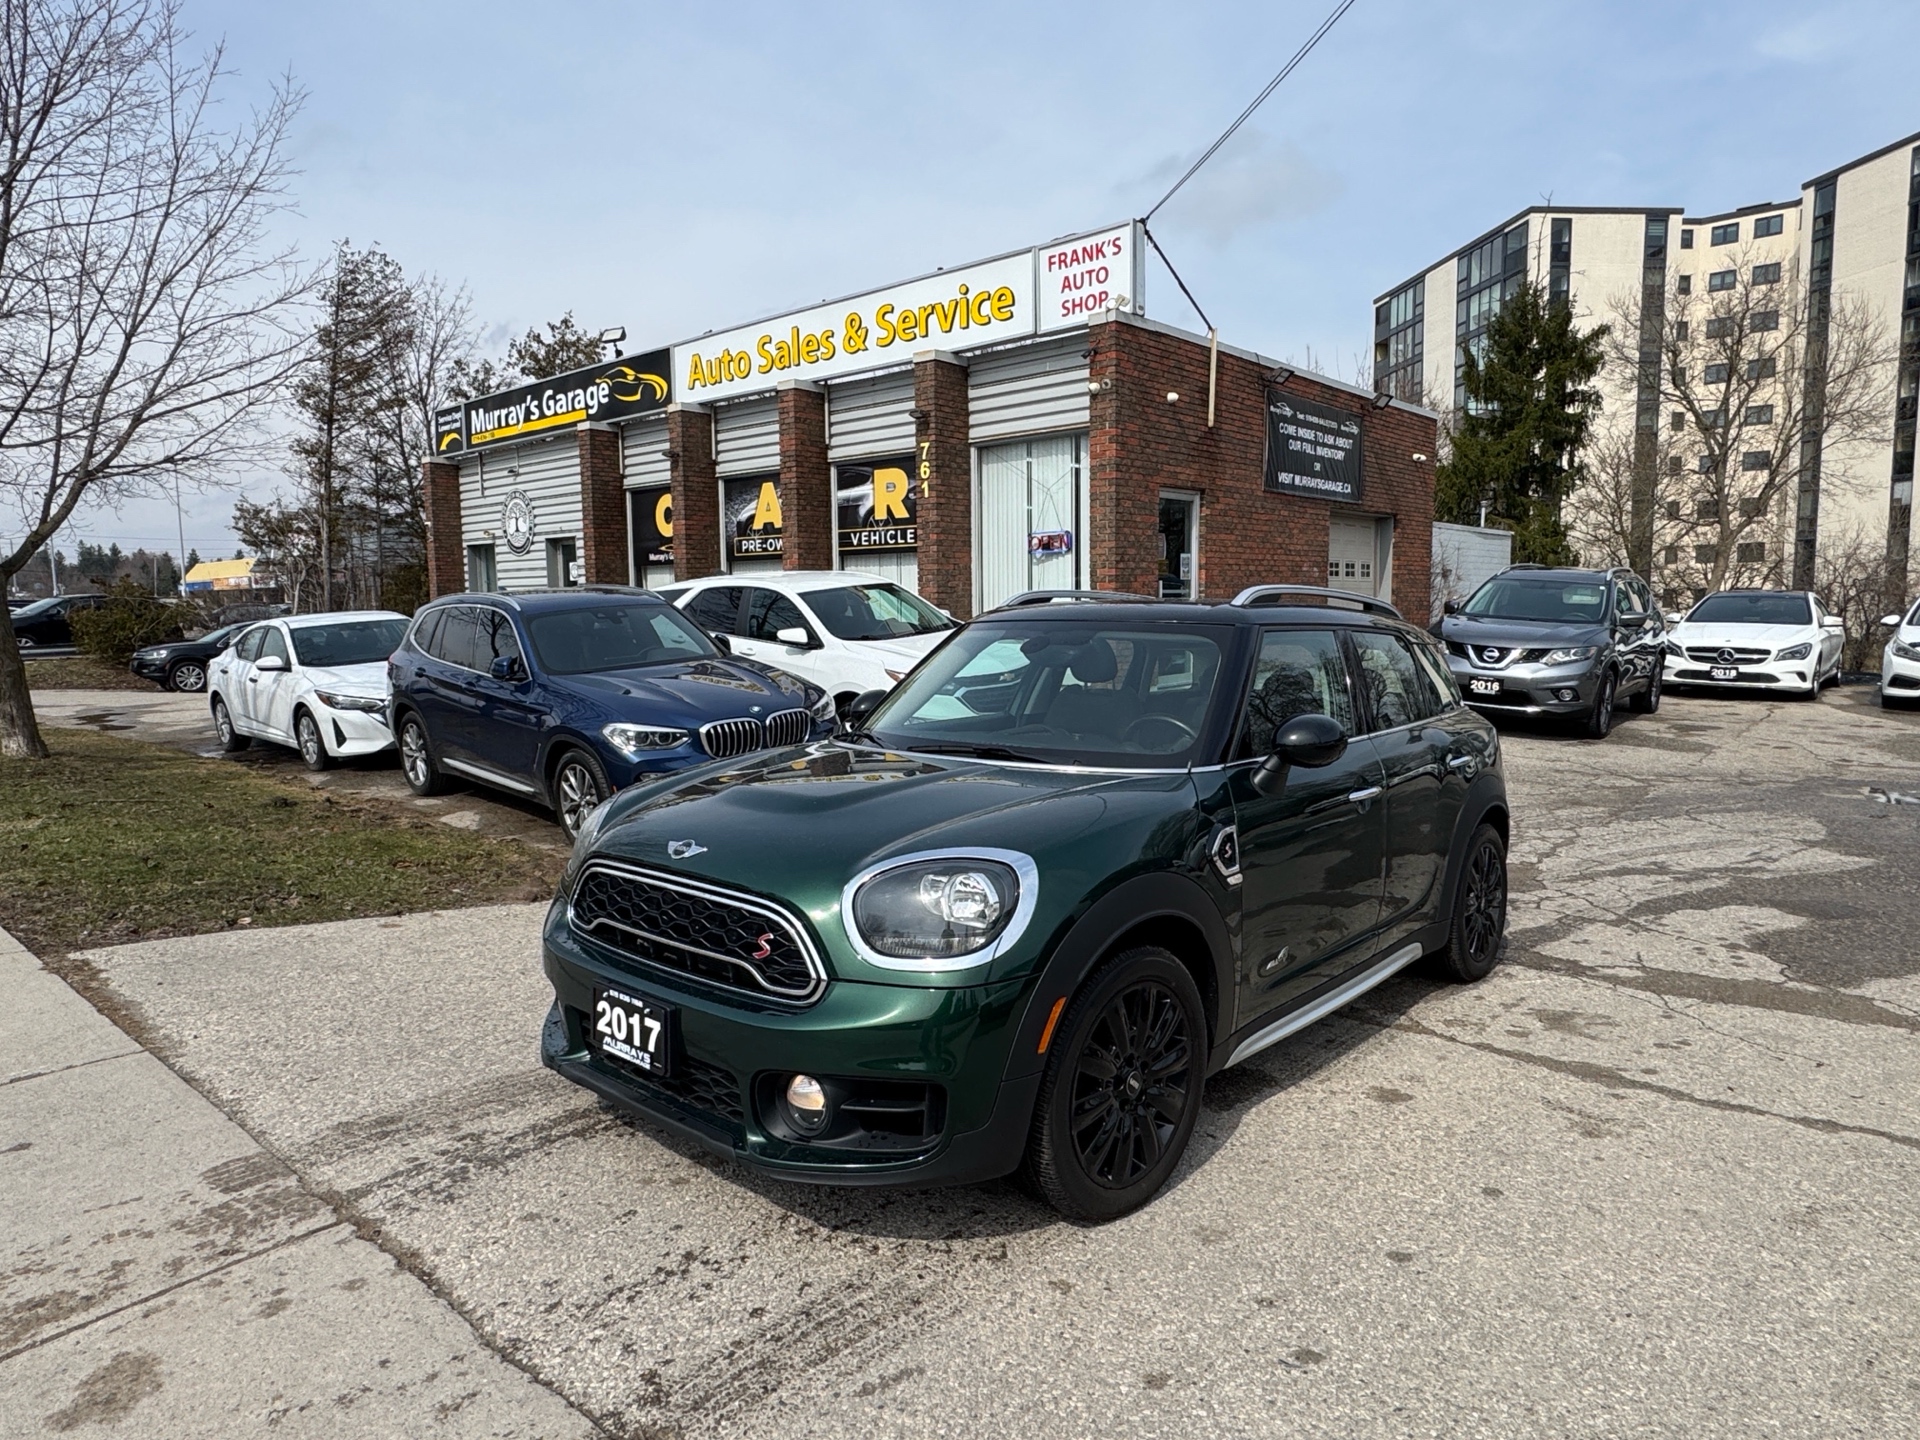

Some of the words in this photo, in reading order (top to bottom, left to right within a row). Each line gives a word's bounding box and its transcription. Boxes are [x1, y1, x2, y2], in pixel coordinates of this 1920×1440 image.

[1047, 236, 1122, 273] FRANK'S
[1060, 266, 1109, 294] AUTO
[1061, 290, 1109, 318] SHOP
[687, 348, 751, 391] Auto
[758, 326, 834, 374] Sales
[842, 312, 868, 354] &
[876, 284, 1015, 349] Service
[471, 395, 539, 434] Murray's
[542, 382, 610, 415] Garage
[1279, 422, 1296, 436] COME
[1298, 426, 1315, 440] INSIDE
[1316, 431, 1324, 443] TO
[1323, 433, 1335, 446] ASK
[1335, 436, 1353, 449] ABOUT
[1288, 439, 1301, 451] OUR
[1302, 442, 1315, 455] FULL
[1316, 446, 1345, 461] INVENTORY
[1277, 471, 1293, 484] VISIT
[1313, 462, 1321, 471] OR
[873, 467, 909, 520] R
[1029, 533, 1069, 551] OPEN
[1470, 680, 1500, 691] 2016
[752, 933, 774, 960] S
[596, 1000, 661, 1053] 2017
[603, 1036, 651, 1063] MURRAYS
